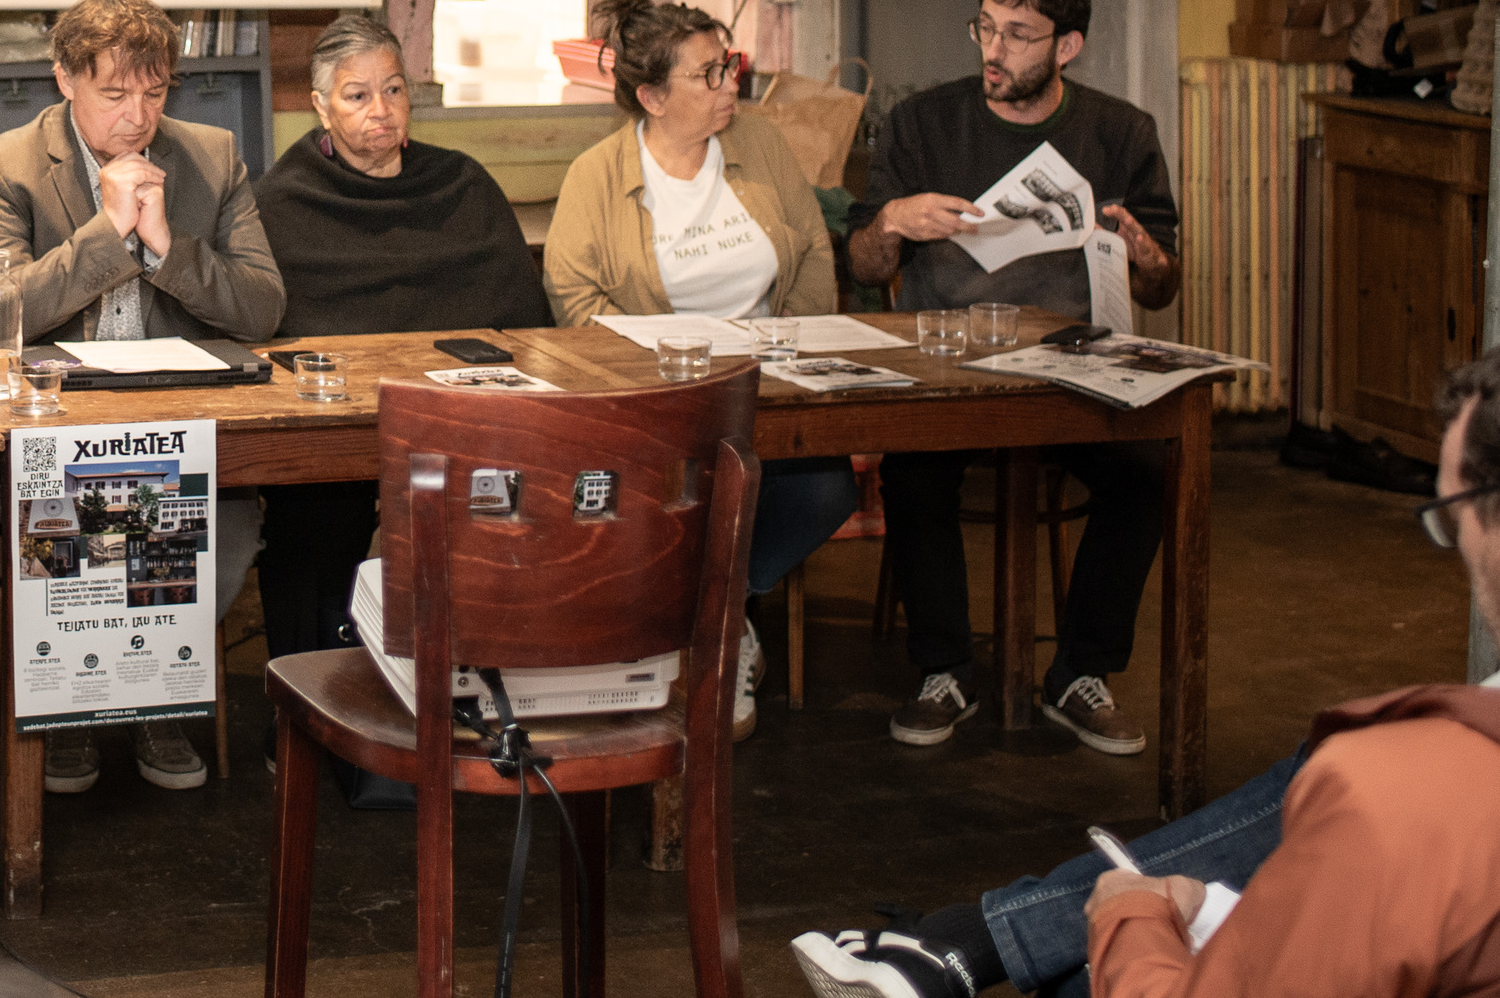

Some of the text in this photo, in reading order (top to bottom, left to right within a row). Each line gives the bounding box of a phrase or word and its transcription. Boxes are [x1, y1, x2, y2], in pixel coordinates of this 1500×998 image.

[684, 223, 715, 240] MINA
[723, 213, 755, 230] ARI
[674, 231, 754, 261] NAHI NUKE
[17, 480, 63, 490] ESKAINTZA
[21, 489, 60, 498] BAT EGIN
[57, 614, 177, 632] TEILATU BAT, LAU ATE
[94, 709, 137, 718] xuriatea.eus
